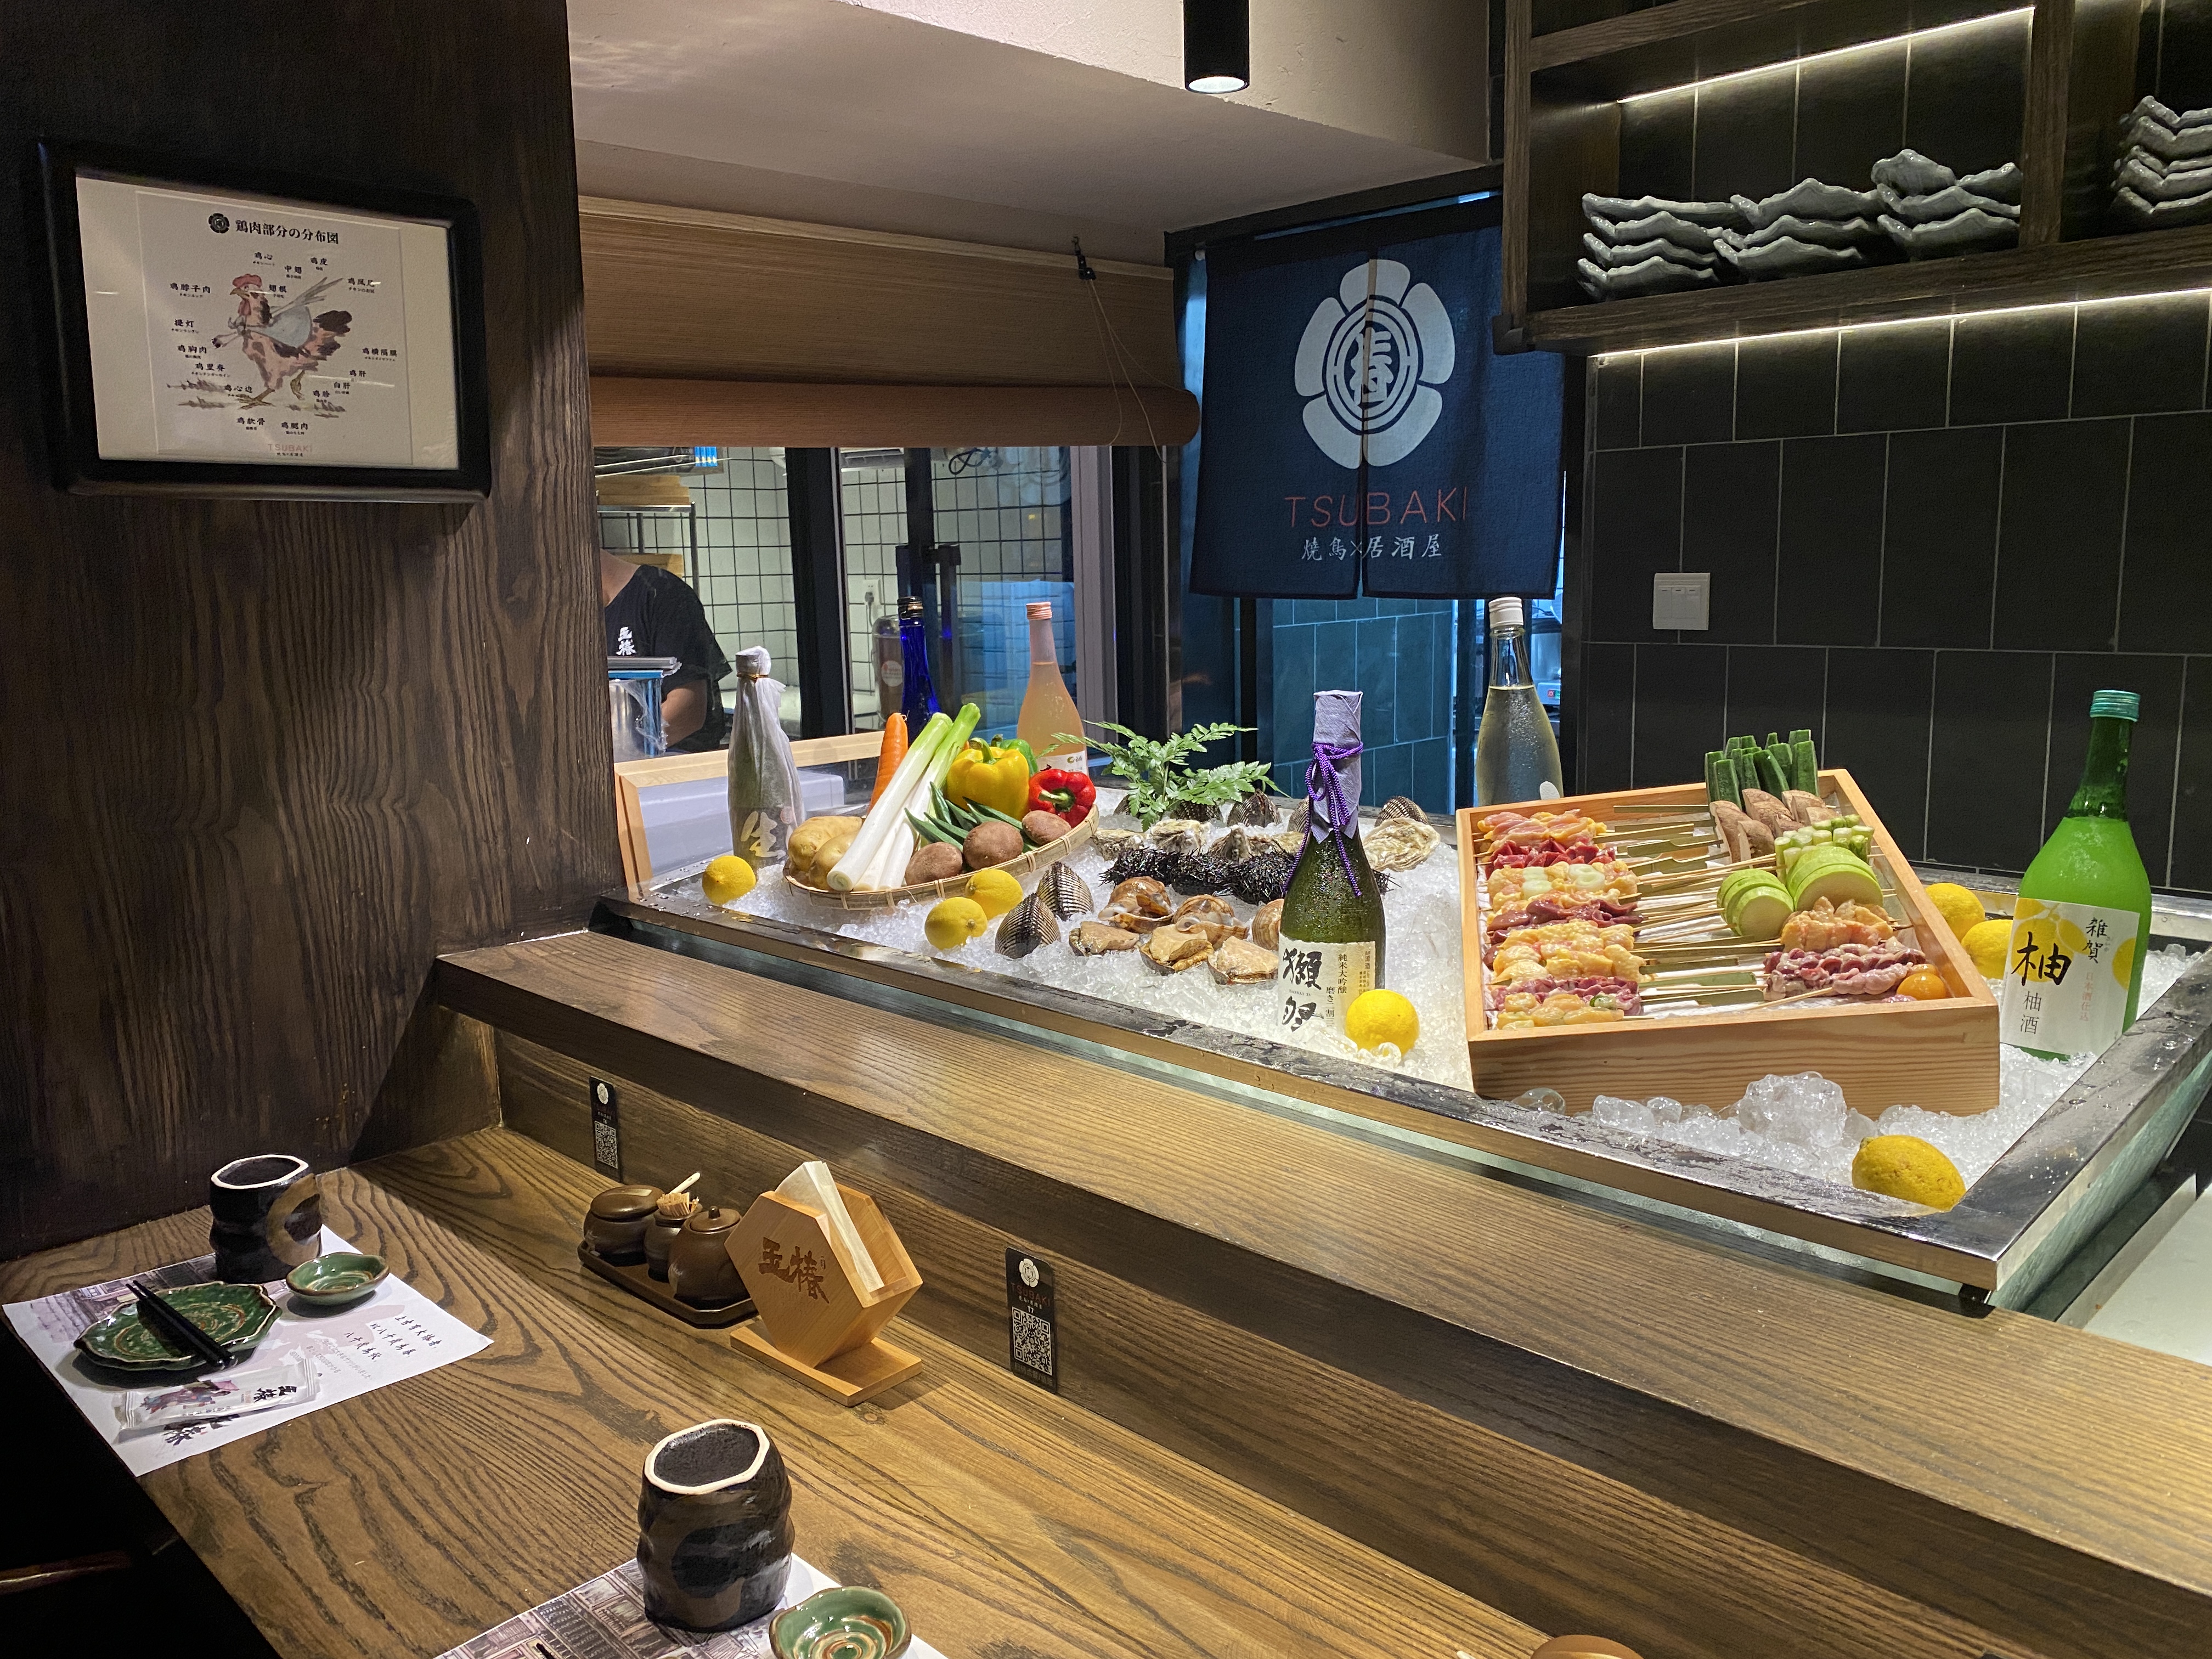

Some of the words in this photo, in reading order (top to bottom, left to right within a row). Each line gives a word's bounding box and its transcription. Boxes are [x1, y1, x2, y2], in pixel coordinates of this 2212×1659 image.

[267, 443, 313, 452] TSUBAKI
[1285, 487, 1468, 528] TSUBAKI
[2011, 931, 2073, 986] 柚
[2019, 990, 2042, 1035] 柚酒
